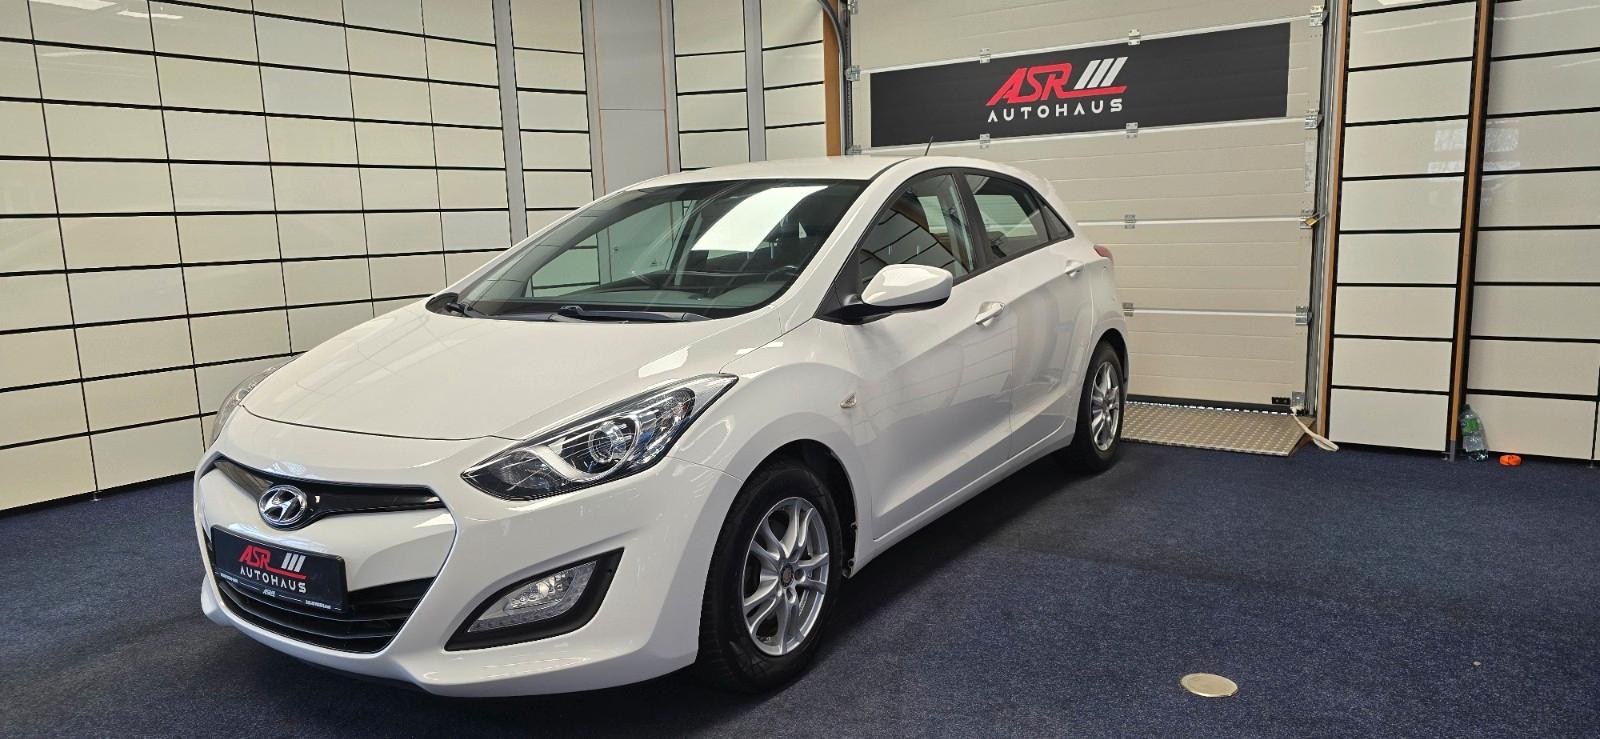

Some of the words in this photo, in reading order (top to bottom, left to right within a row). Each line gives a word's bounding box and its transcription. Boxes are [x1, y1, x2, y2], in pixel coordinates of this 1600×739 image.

[986, 62, 1078, 106] ASR
[987, 98, 1123, 123] AUTOHAUS
[240, 566, 307, 594] AUTOHAUS
